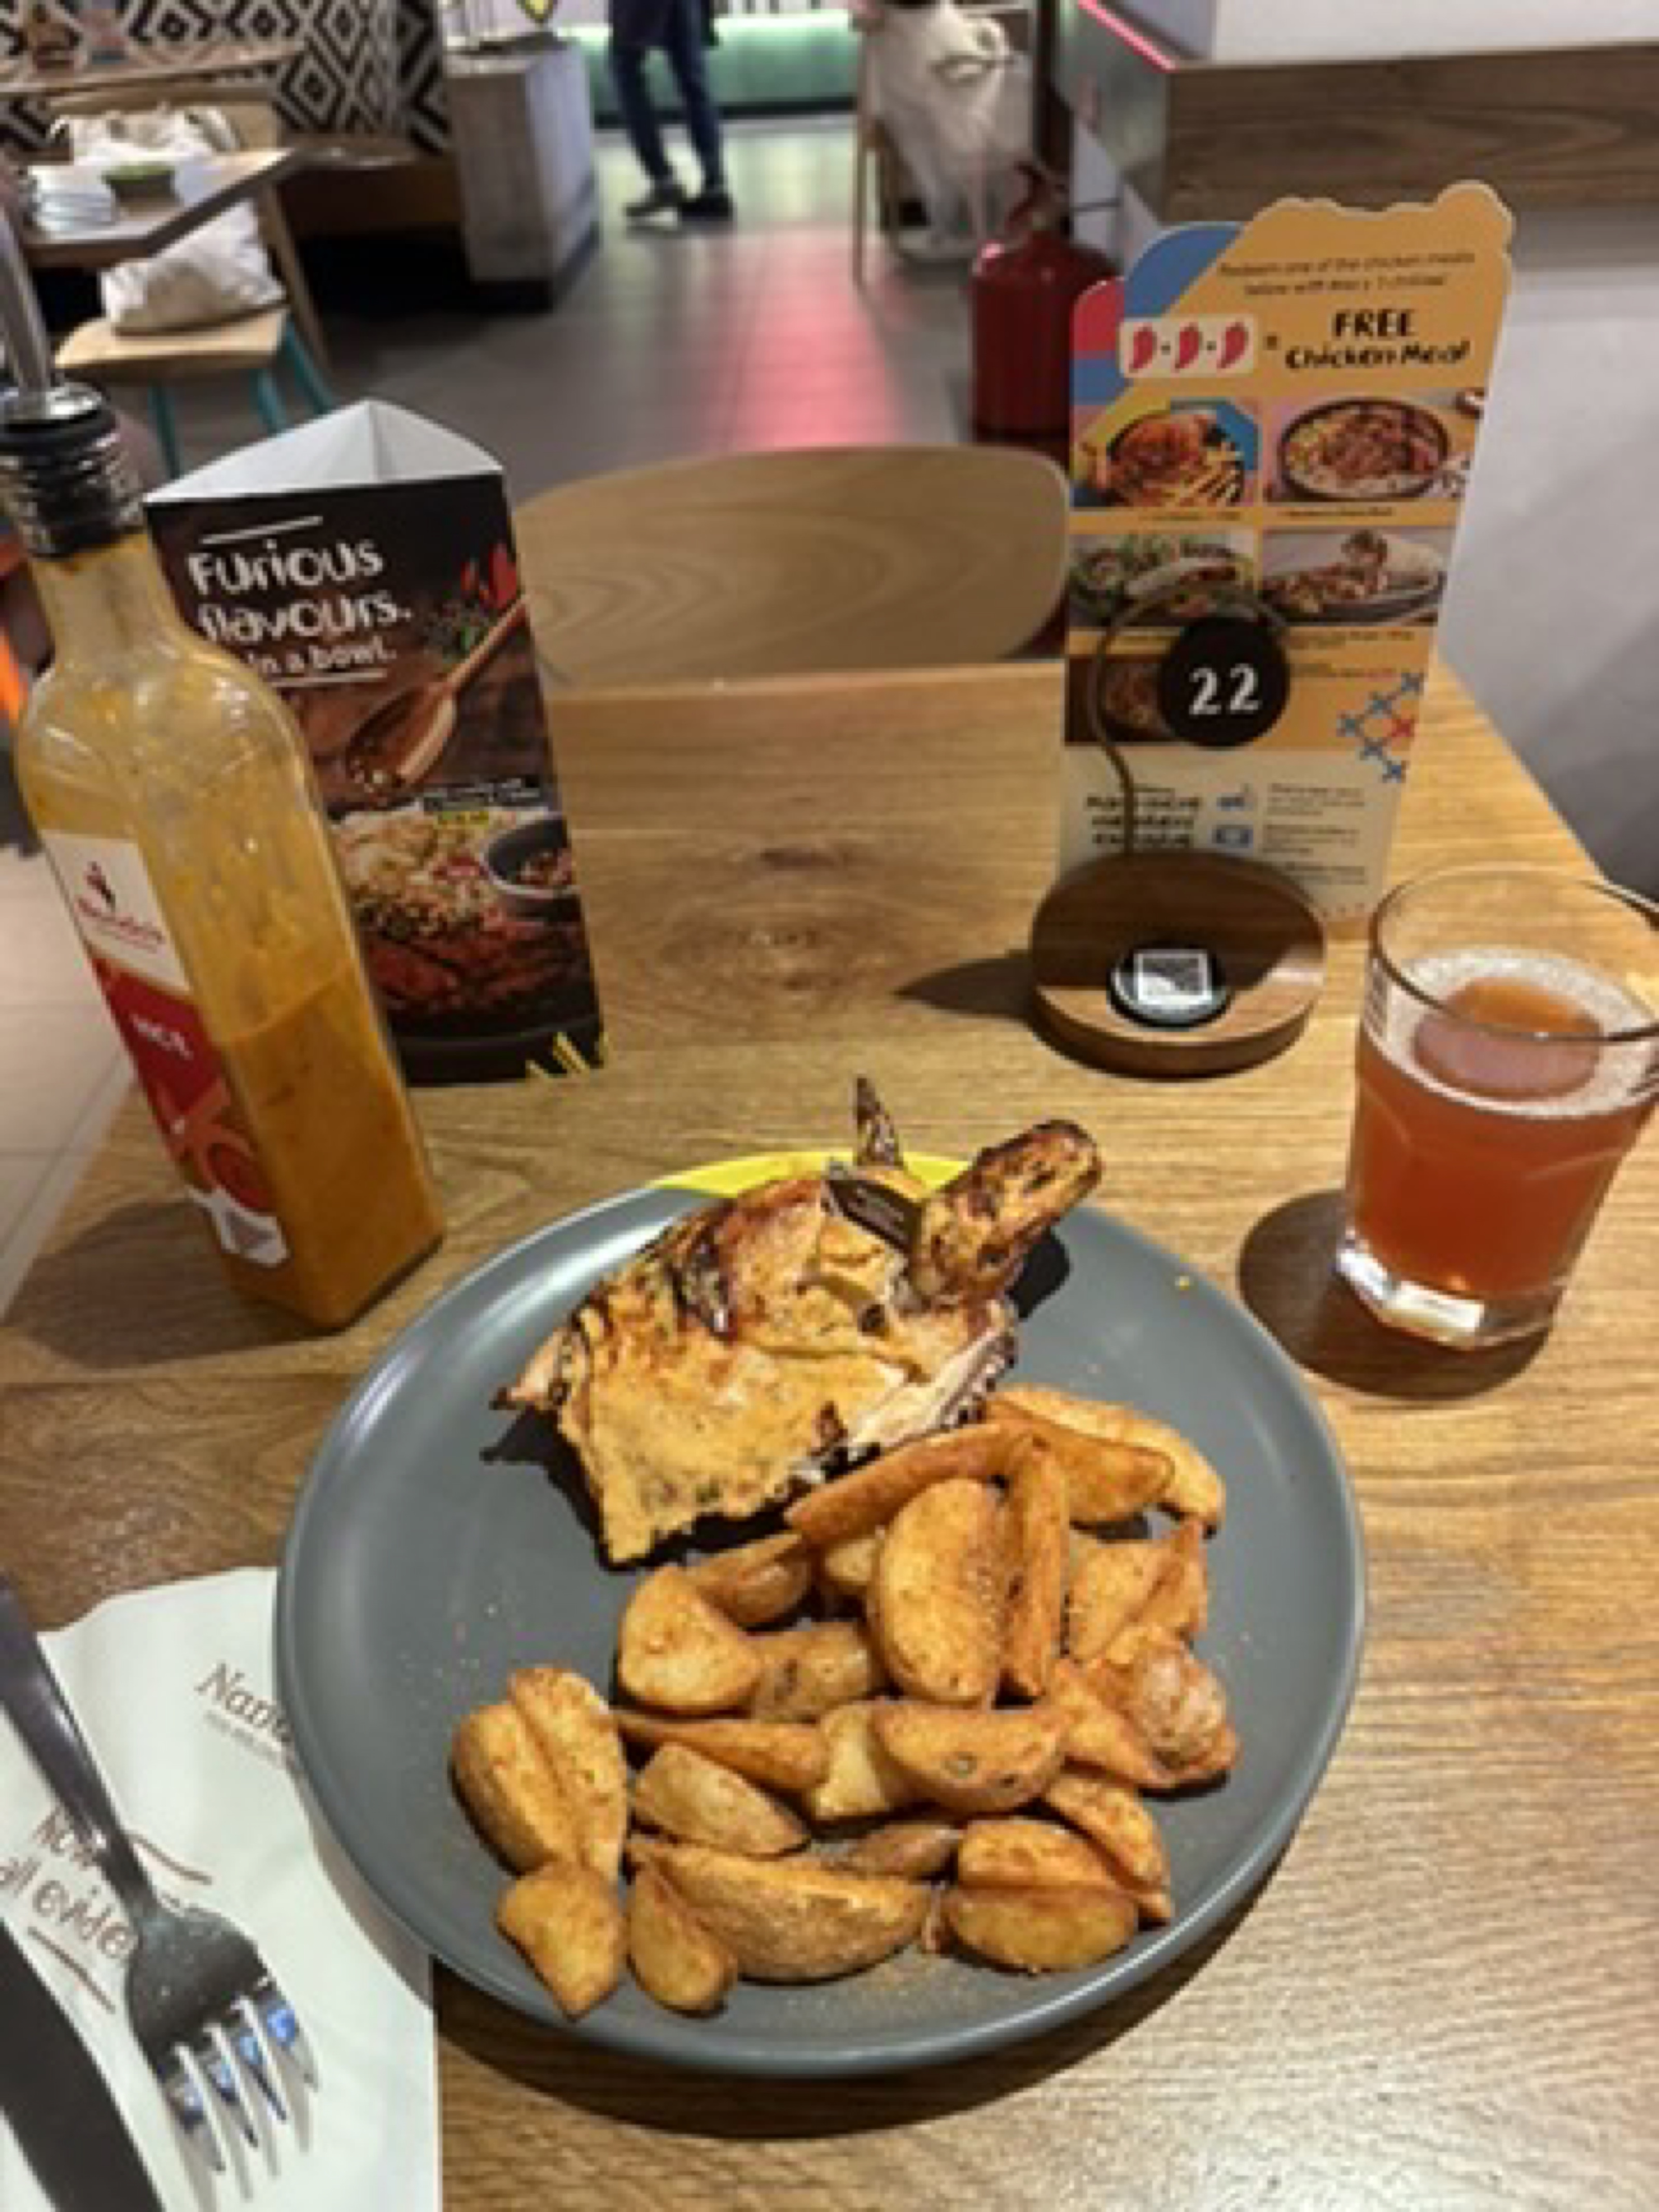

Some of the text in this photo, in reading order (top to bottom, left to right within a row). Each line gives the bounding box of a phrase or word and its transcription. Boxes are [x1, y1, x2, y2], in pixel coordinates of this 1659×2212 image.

[1332, 308, 1417, 339] FREE
[1285, 340, 1471, 369] Chicken Meal
[286, 653, 305, 674] a
[308, 635, 398, 670] bowl.
[1188, 663, 1261, 716] 22
